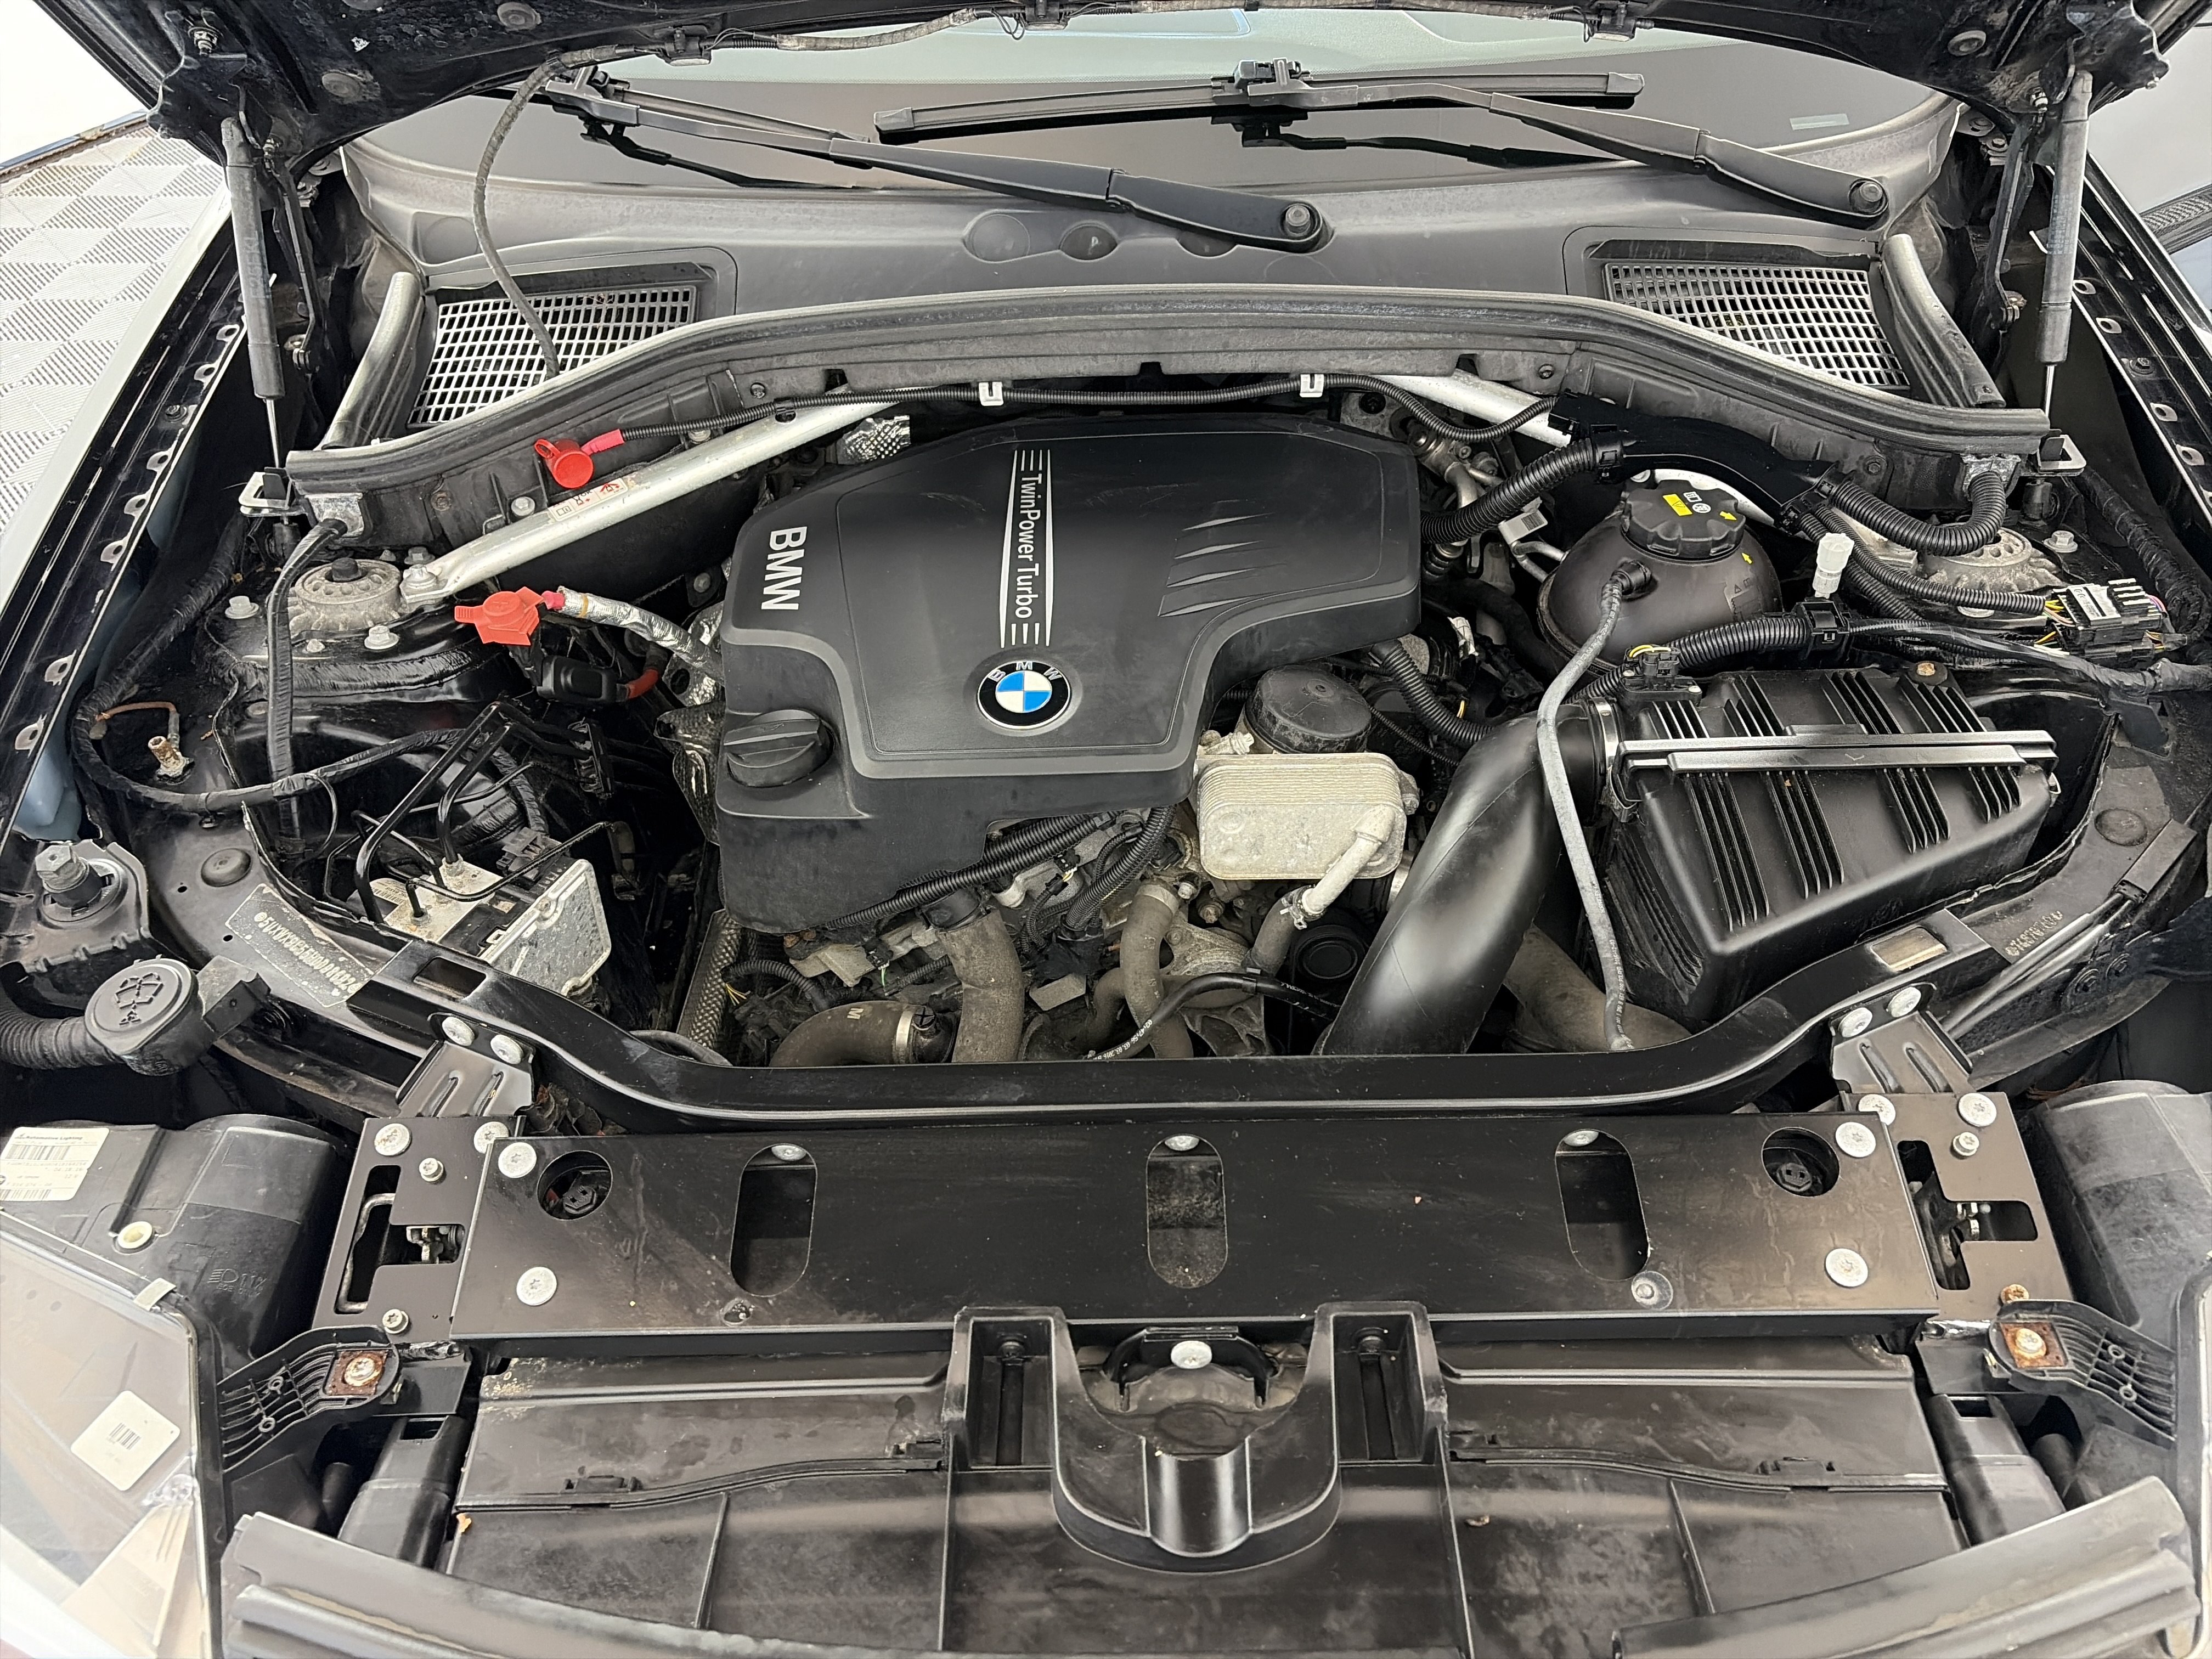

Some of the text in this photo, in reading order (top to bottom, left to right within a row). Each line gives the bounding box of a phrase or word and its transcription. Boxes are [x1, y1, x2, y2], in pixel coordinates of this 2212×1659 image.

[761, 526, 808, 610] BMW
[1015, 473, 1042, 618] TwinPower Turbo
[988, 661, 1062, 682] BMW
